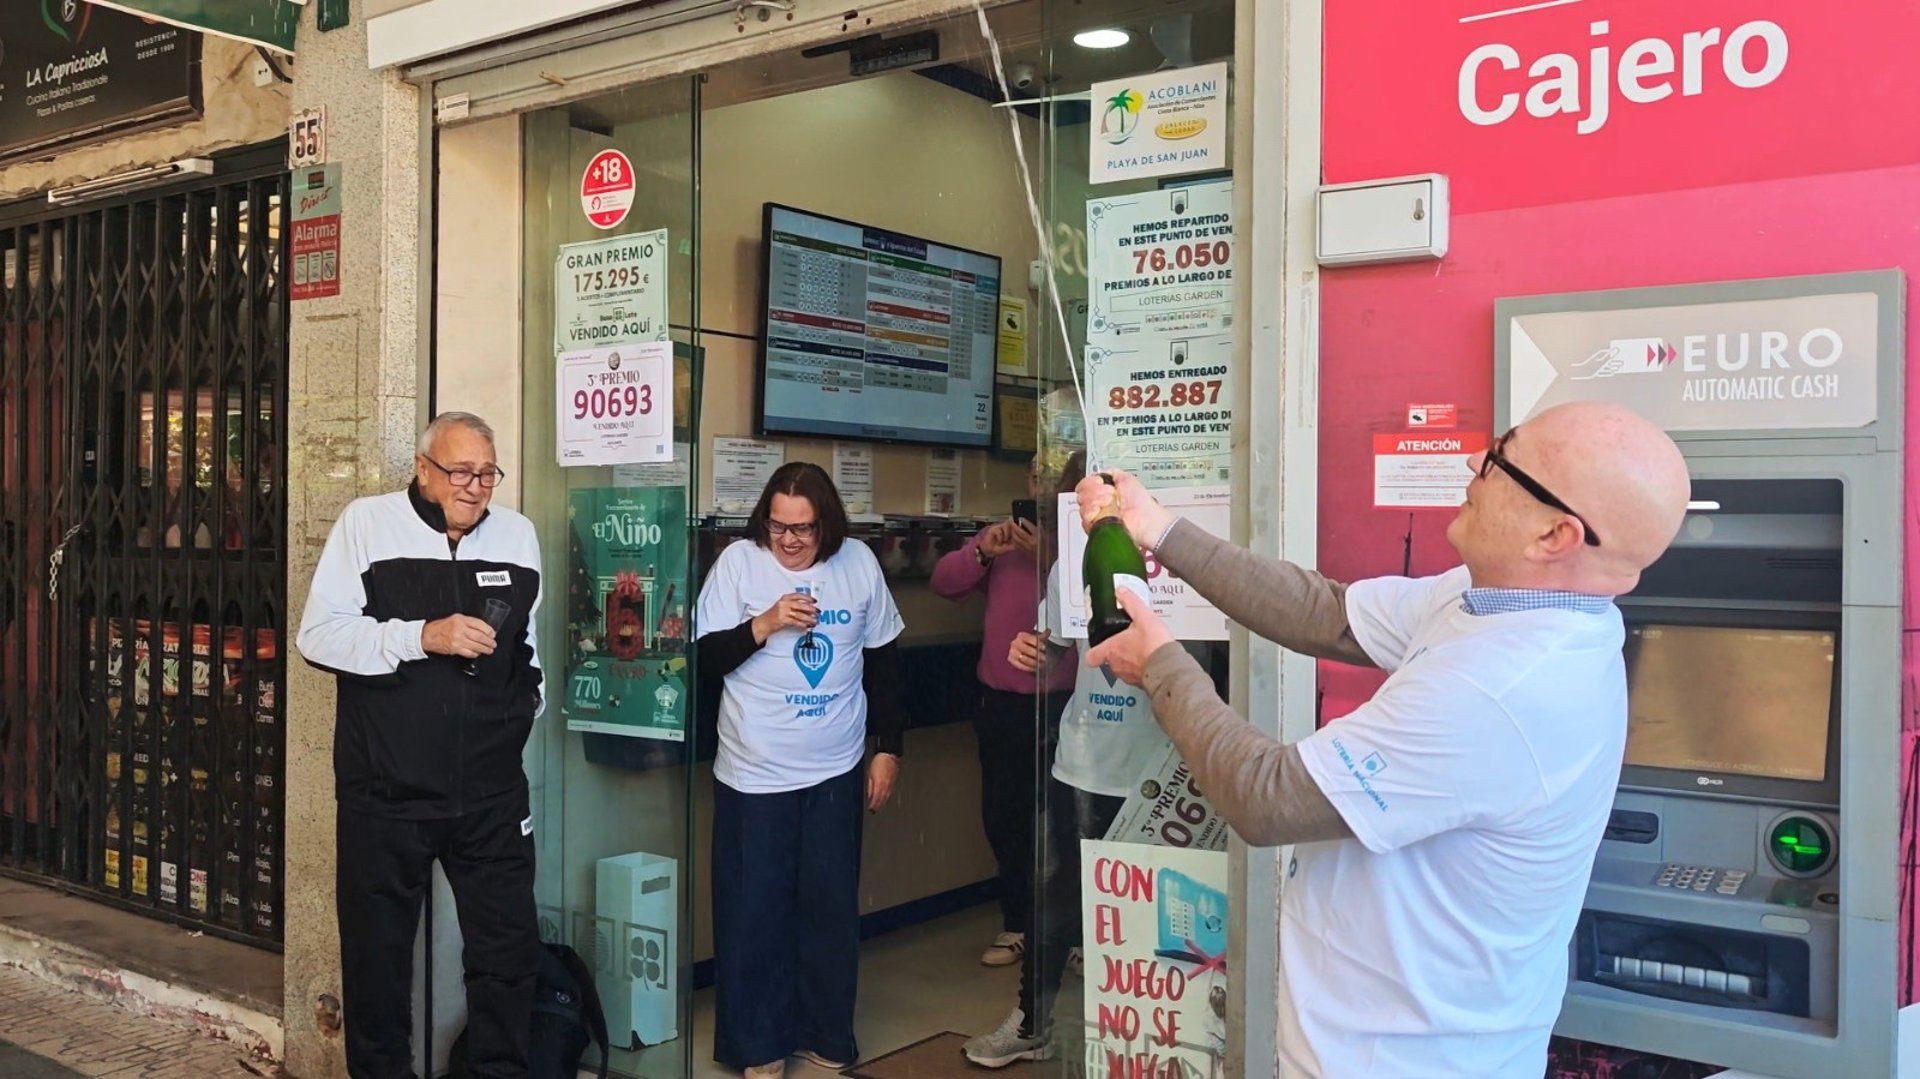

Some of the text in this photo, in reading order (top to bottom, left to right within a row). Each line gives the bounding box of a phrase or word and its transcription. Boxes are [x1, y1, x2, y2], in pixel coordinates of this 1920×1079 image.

[26, 68, 42, 88] LA
[1457, 19, 1789, 135] Cajero
[1148, 80, 1216, 100] ACOBLANI
[295, 119, 318, 158] 55
[1107, 148, 1208, 169] PLAYA DE SAN JUAN
[592, 158, 622, 183] +18
[295, 223, 337, 242] Alarma
[1133, 213, 1229, 233] HEMOS REPARTIDO
[1119, 237, 1132, 247] EN
[1134, 234, 1157, 245] ESTE
[1159, 230, 1193, 242] PUNTO
[1195, 228, 1209, 238] DE
[566, 244, 653, 269] GRAN PREMIO
[1132, 240, 1230, 274] 76.050
[574, 266, 649, 293] 175.295 €
[1104, 269, 1232, 291] PREMIOS A LO LARGO DE
[1138, 290, 1224, 306] LOTERÍAS GARDEN
[570, 317, 650, 341] VENDIDO AQUÍ
[1681, 327, 1844, 373] EURO
[600, 370, 640, 386] PREMIO
[1130, 365, 1227, 381] HEMOS ENTREGADO
[1108, 379, 1222, 409] 882.887
[1682, 374, 1839, 402] AUTOMATIC CASH
[574, 384, 653, 420] 90693
[977, 402, 986, 413] 22
[1097, 417, 1110, 426] EN
[1159, 414, 1166, 423] A
[1168, 413, 1182, 422] LO
[1184, 411, 1218, 421] LARGO
[1116, 428, 1129, 437] EN
[1131, 426, 1156, 436] ESTE
[1157, 424, 1191, 435] PUNTO
[1193, 424, 1207, 433] DE
[1135, 441, 1220, 454] LOTERÍAS GARDEN
[1396, 438, 1461, 452] ATENCIÓN
[604, 513, 662, 547] Niño
[481, 575, 506, 584] PUMA
[574, 675, 601, 700] 770
[1088, 692, 1137, 707] VENDIDO
[1096, 709, 1124, 722] AQUÍ
[1094, 857, 1153, 903] CON
[1095, 904, 1127, 946] EL
[1097, 954, 1185, 1002] JUEGO
[1099, 1002, 1182, 1048] NO SE
[1105, 1049, 1182, 1079] JUEGA
